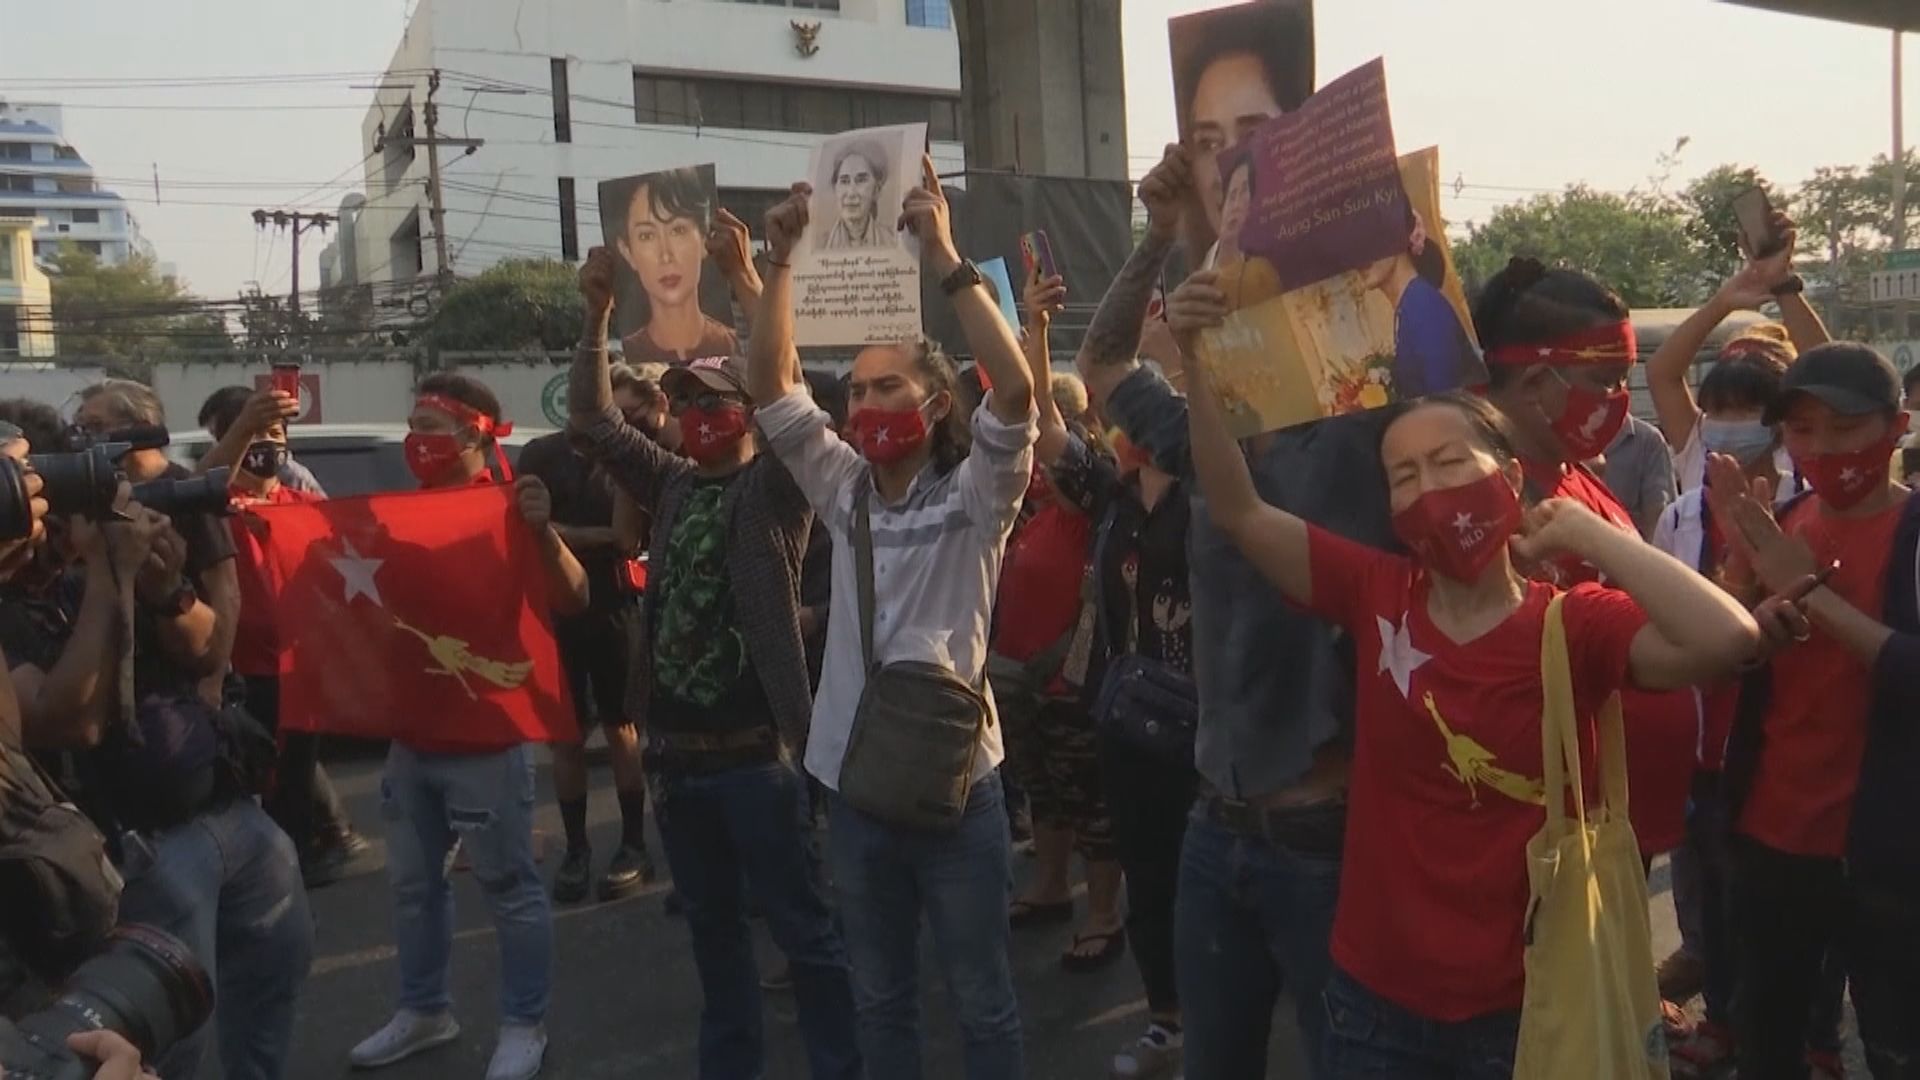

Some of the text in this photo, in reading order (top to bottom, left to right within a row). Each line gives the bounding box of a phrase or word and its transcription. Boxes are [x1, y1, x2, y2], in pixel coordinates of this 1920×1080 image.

[1312, 206, 1341, 226] San
[1344, 195, 1370, 216] Suu
[1374, 186, 1398, 206] Kyi
[1460, 528, 1484, 551] NLD
